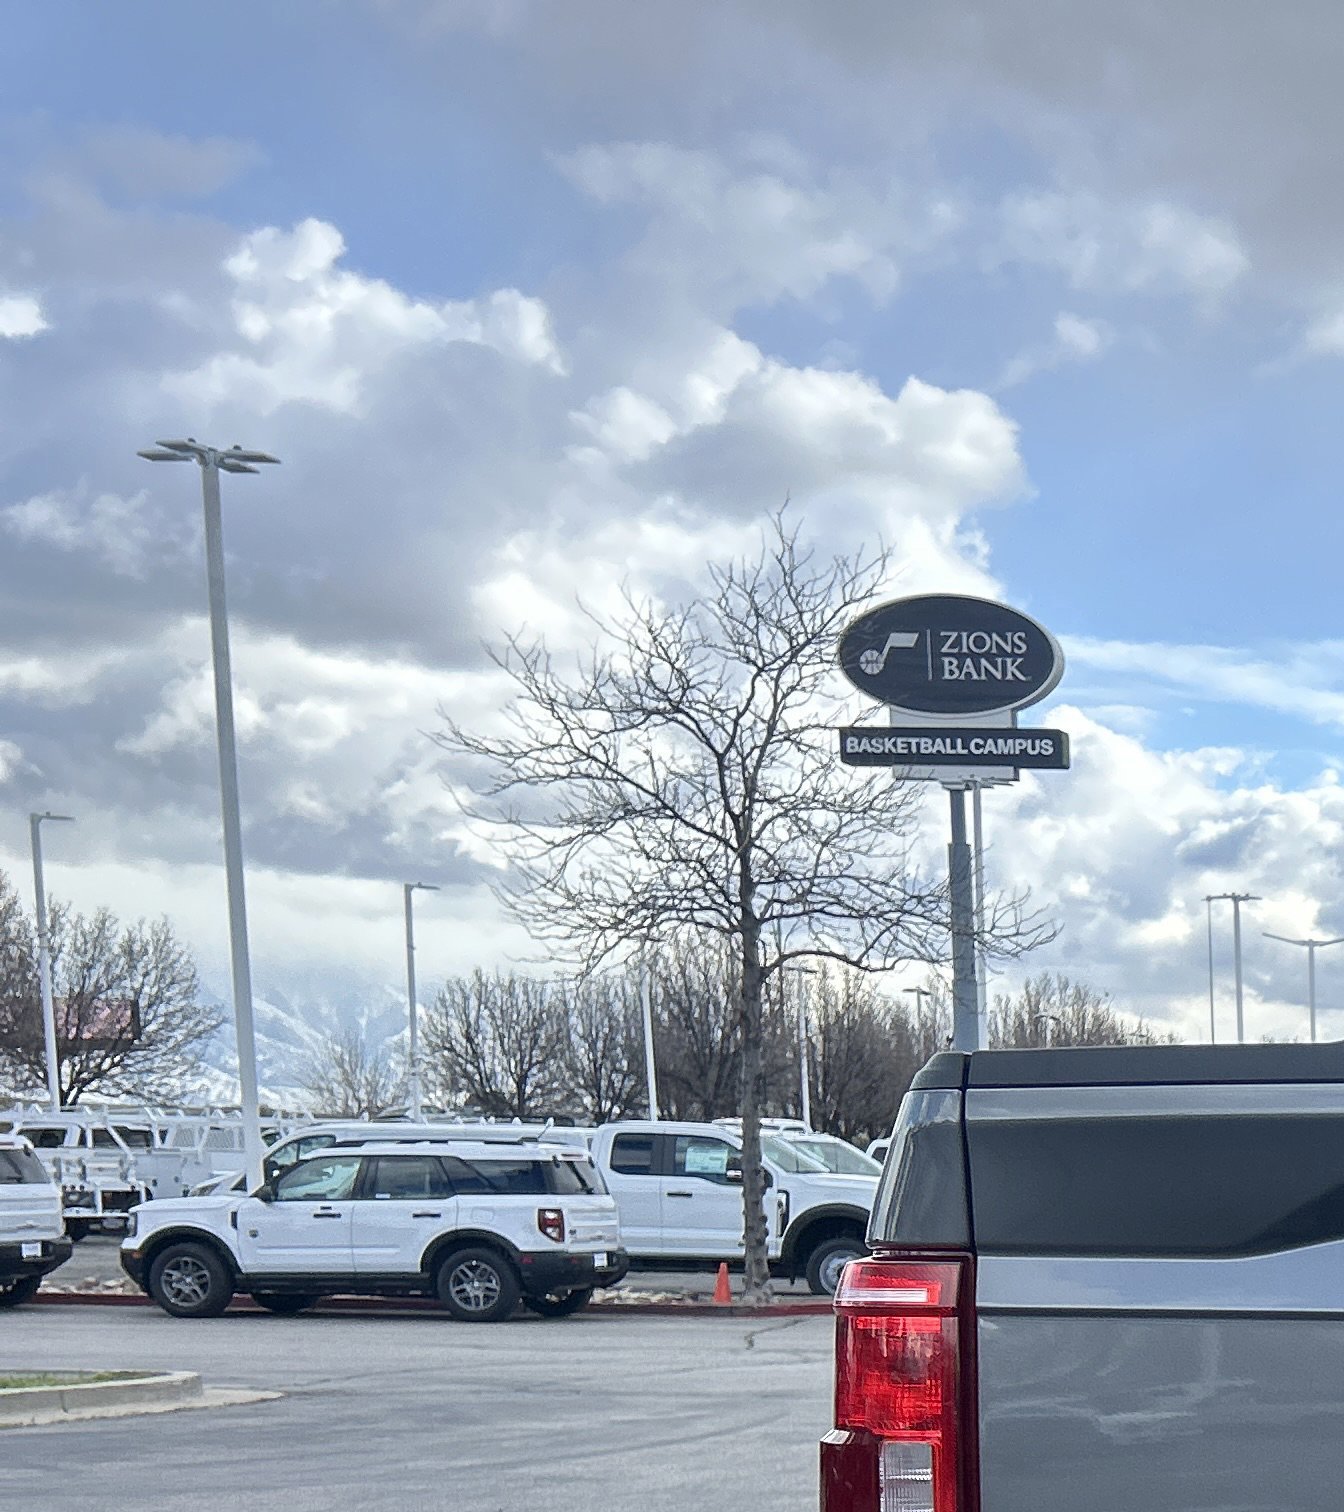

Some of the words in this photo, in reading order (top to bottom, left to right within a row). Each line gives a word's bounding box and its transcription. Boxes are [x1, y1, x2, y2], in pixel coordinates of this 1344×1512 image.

[940, 631, 1027, 653] ZIONS
[942, 658, 1028, 680] BANK
[846, 737, 968, 755] BASKETBALL
[970, 738, 1053, 755] CAMPUS
